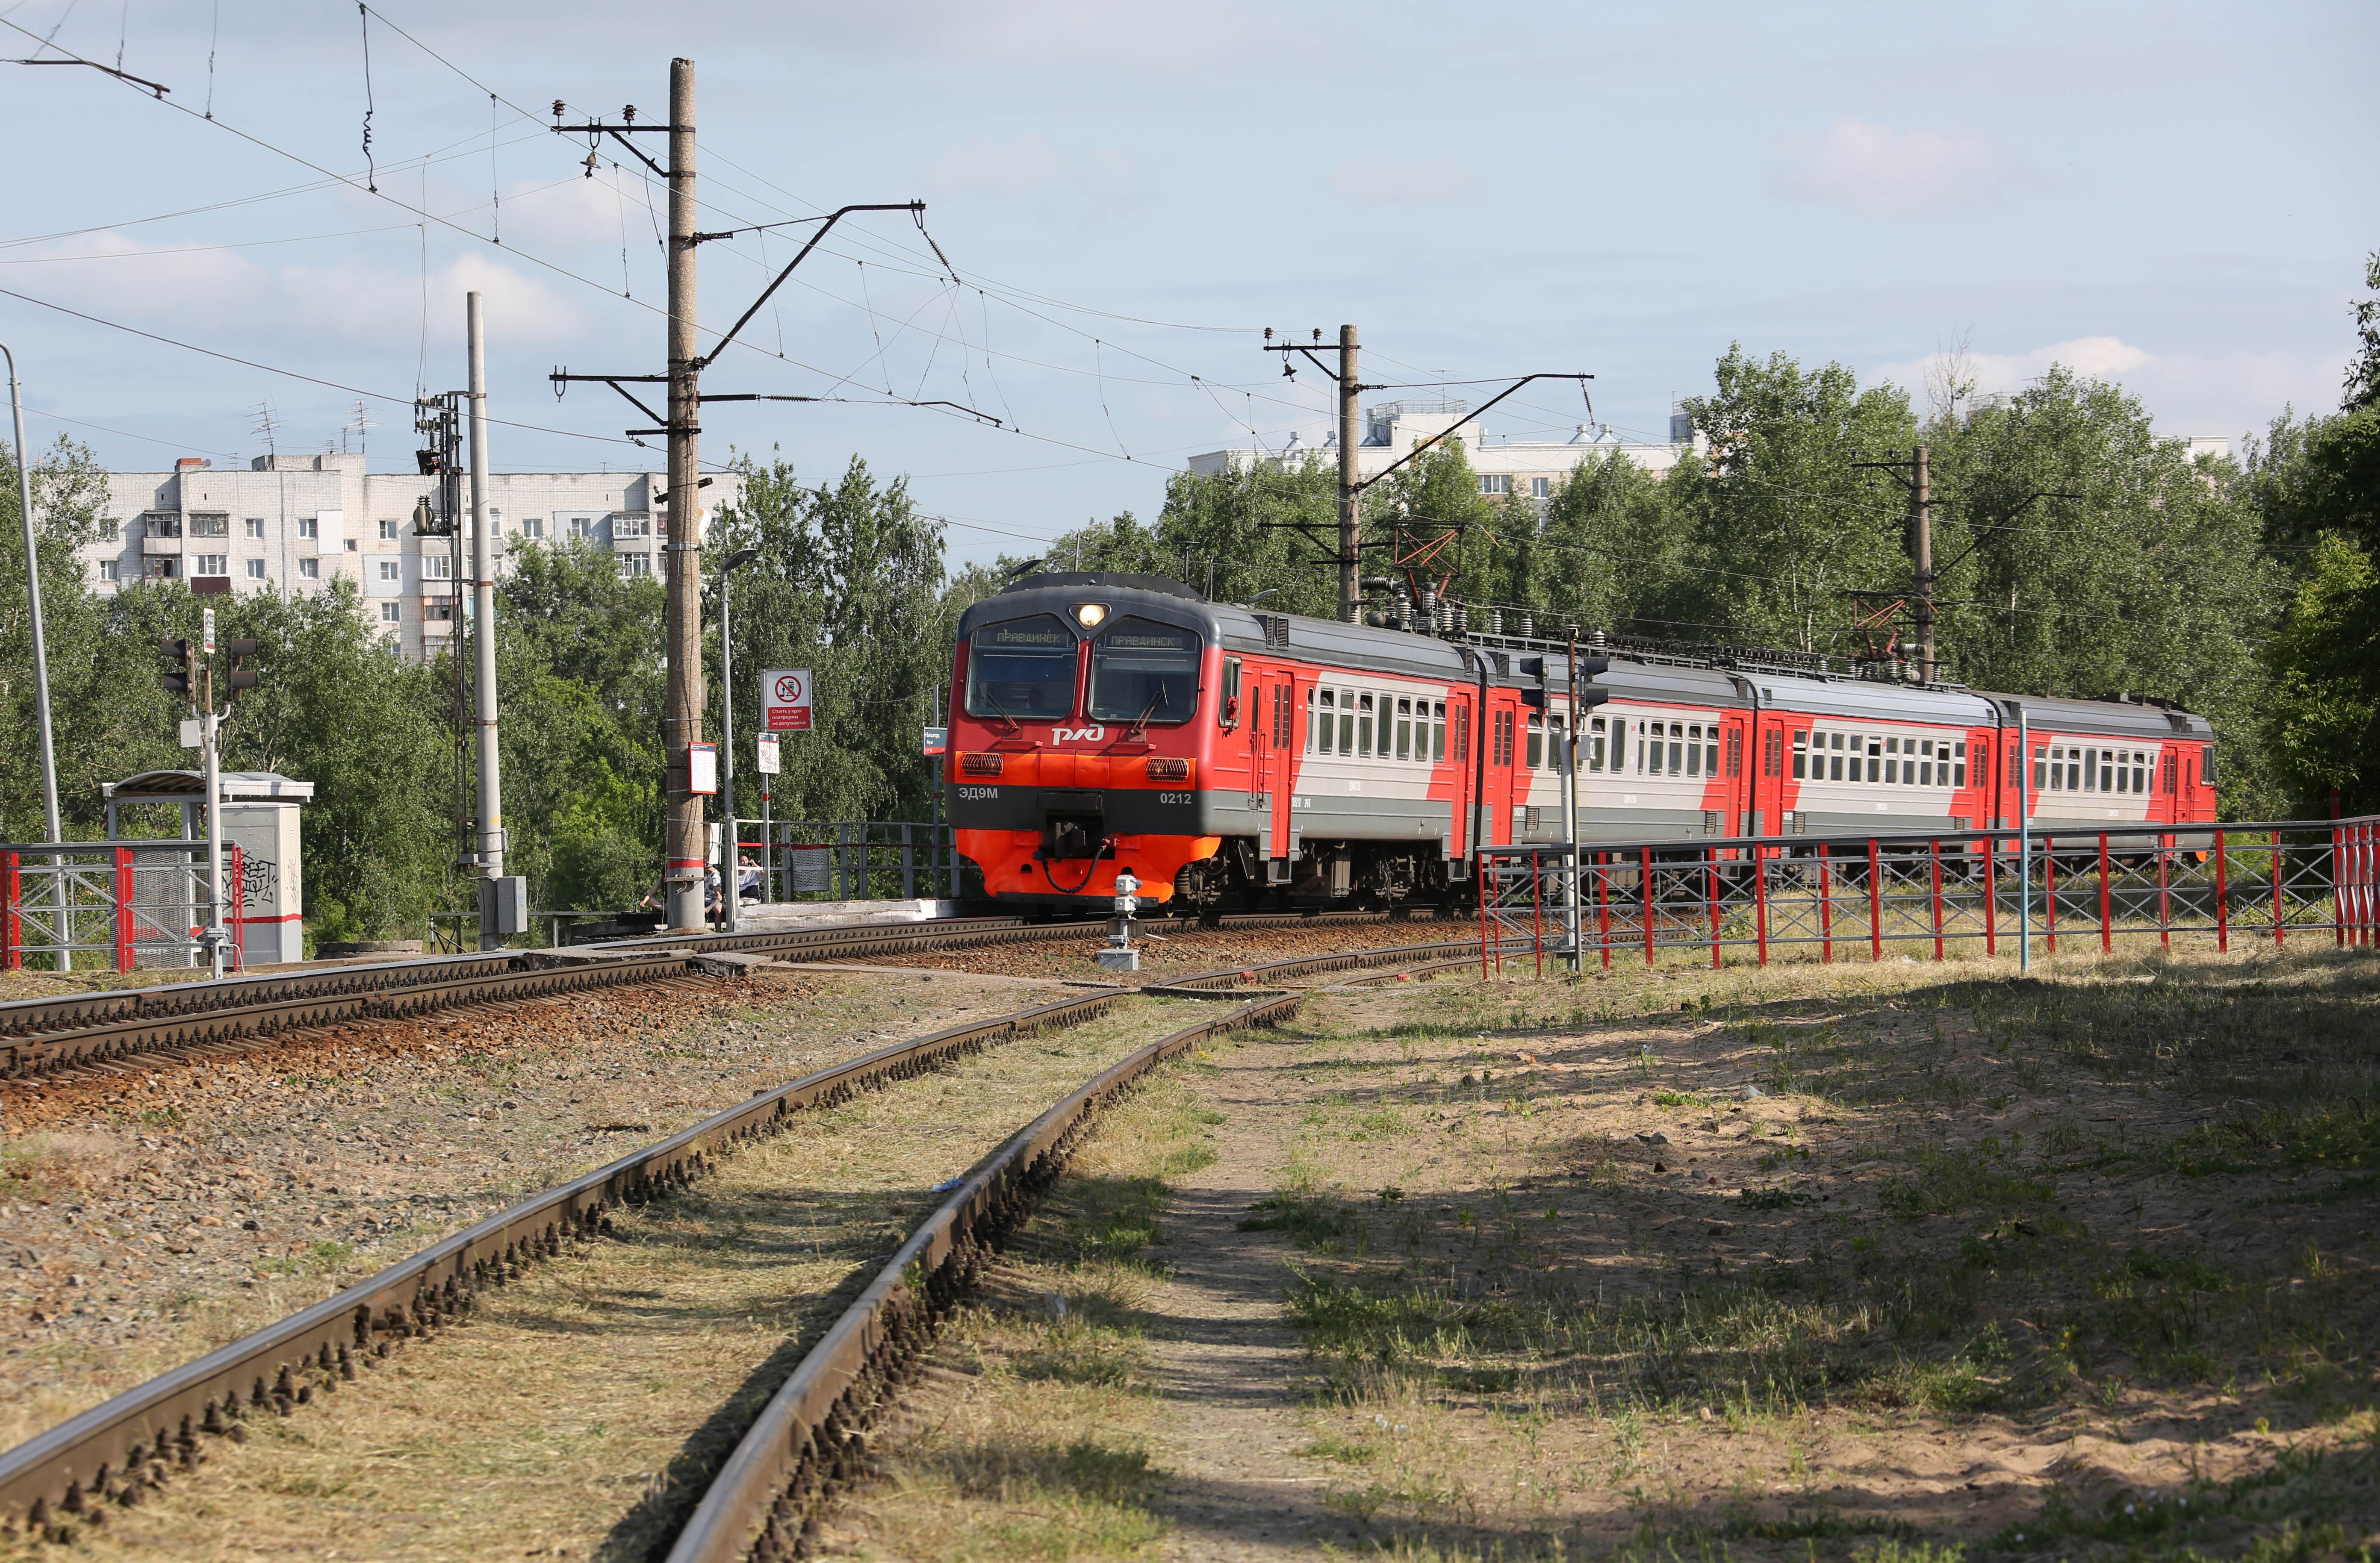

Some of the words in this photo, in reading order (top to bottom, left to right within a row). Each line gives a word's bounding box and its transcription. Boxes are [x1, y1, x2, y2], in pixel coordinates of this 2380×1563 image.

[997, 633, 1060, 643] ПРАВДИНСК
[1112, 636, 1174, 646] ПРАВДИНСК
[958, 787, 998, 800] ЭД9М
[1160, 793, 1191, 804] 0212
